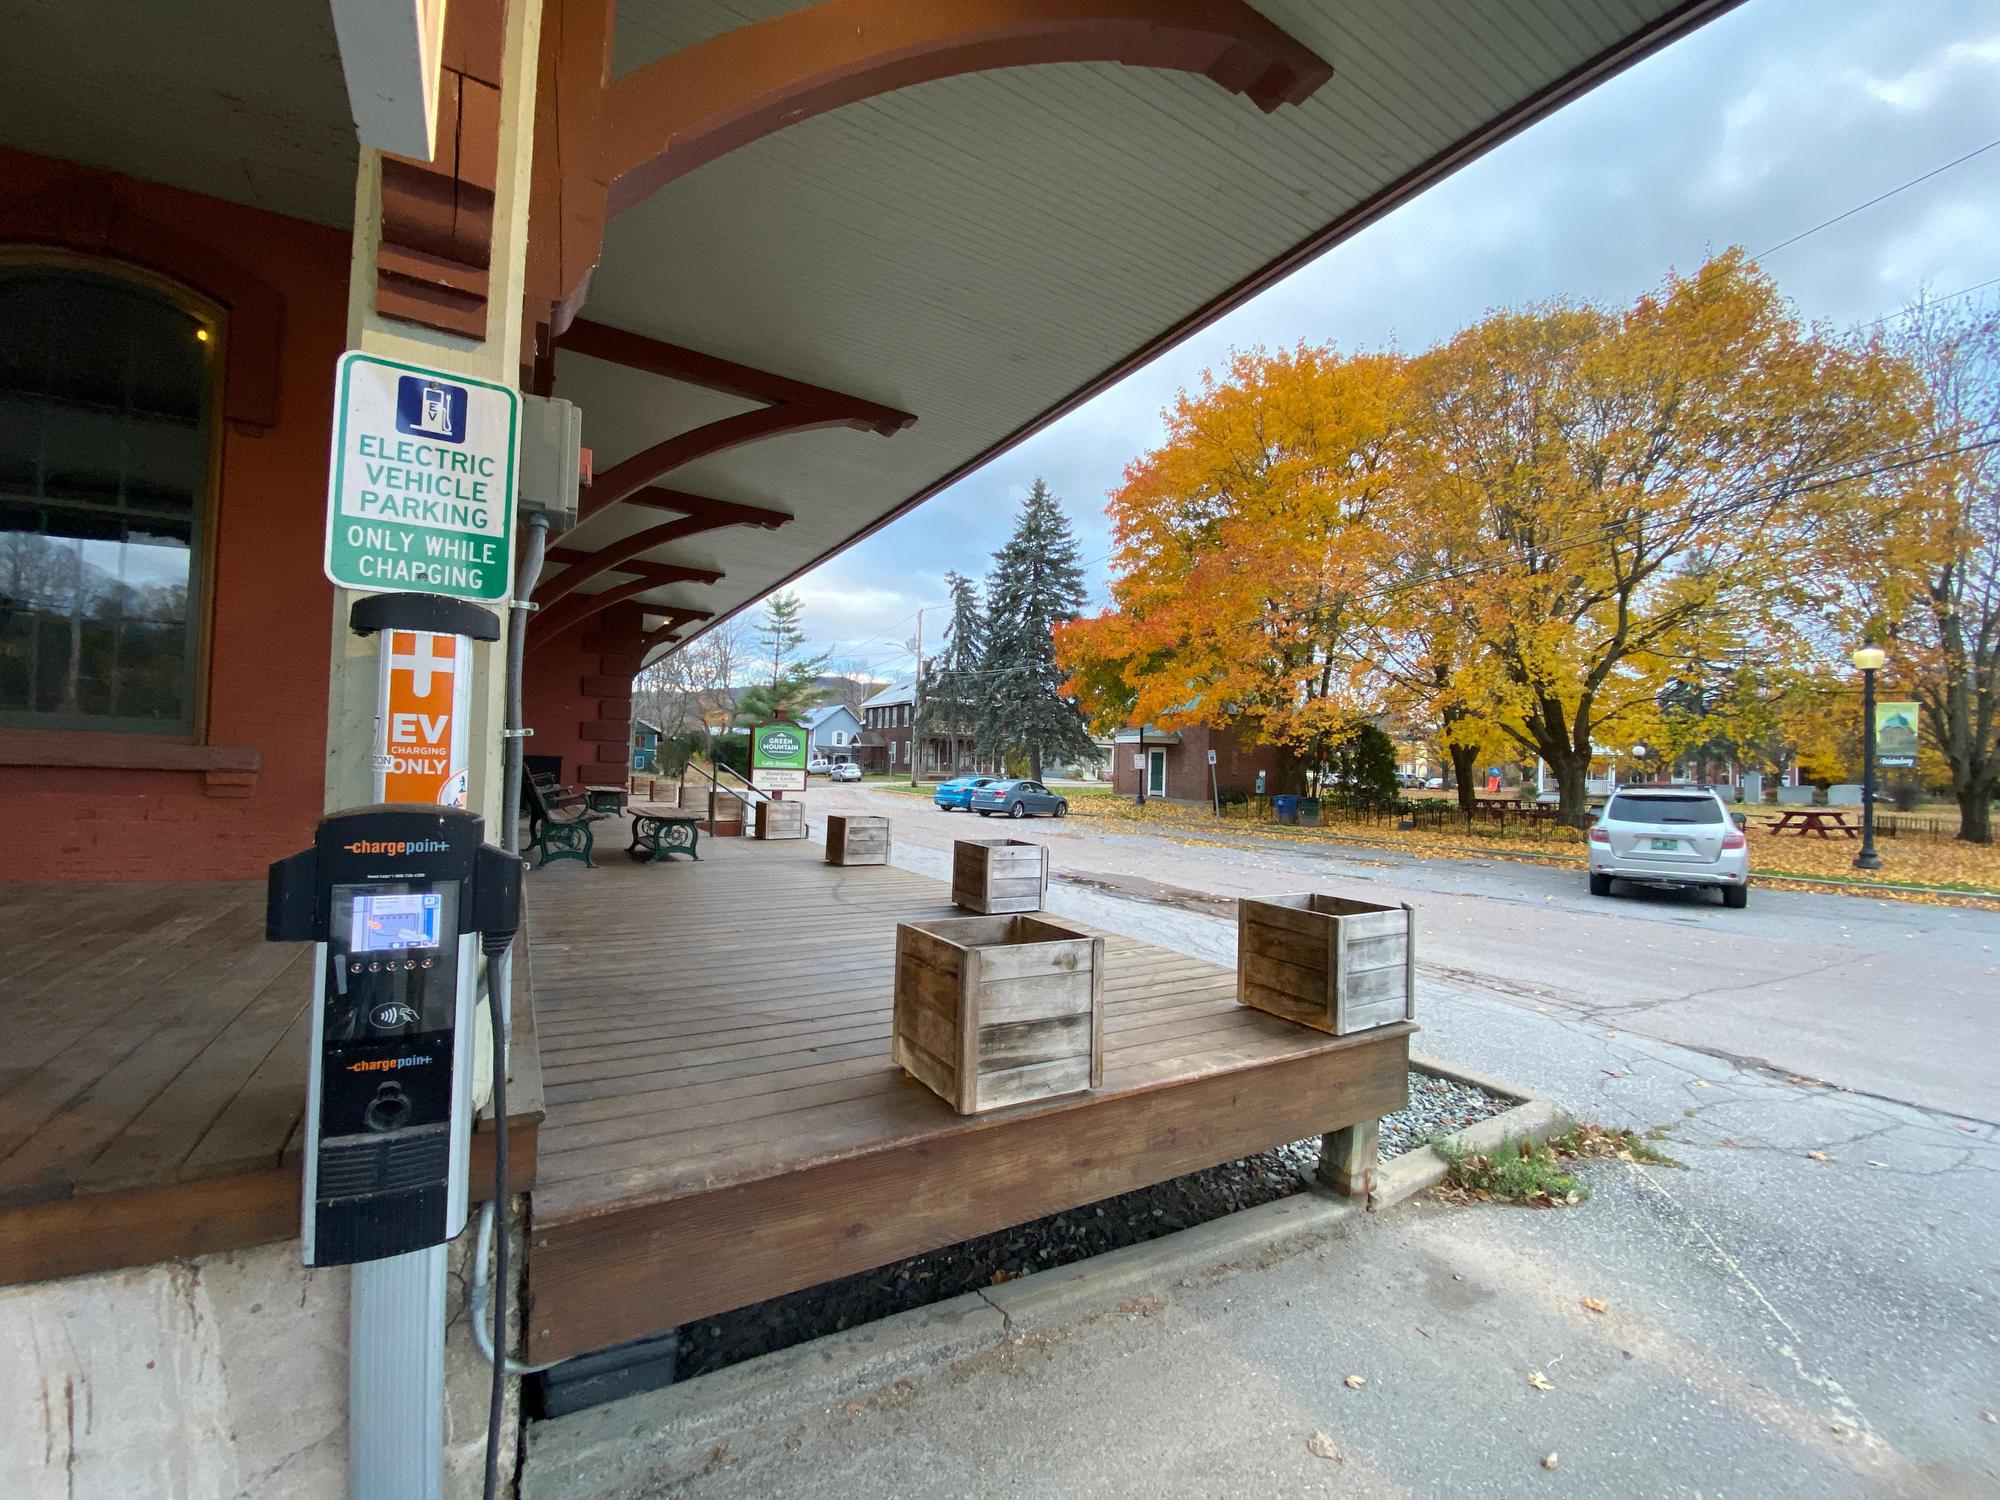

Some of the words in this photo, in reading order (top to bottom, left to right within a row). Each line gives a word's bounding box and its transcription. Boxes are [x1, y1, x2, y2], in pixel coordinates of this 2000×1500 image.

[360, 434, 495, 478] ELECTRIC
[365, 463, 488, 503] VEHICLE
[360, 490, 488, 529] PARKING
[348, 525, 414, 553] ONLY
[425, 535, 496, 565] WHILE
[359, 555, 483, 589] CHARGING
[392, 713, 449, 744] EV
[391, 746, 447, 756] CHARGING
[392, 758, 448, 775] ONLY
